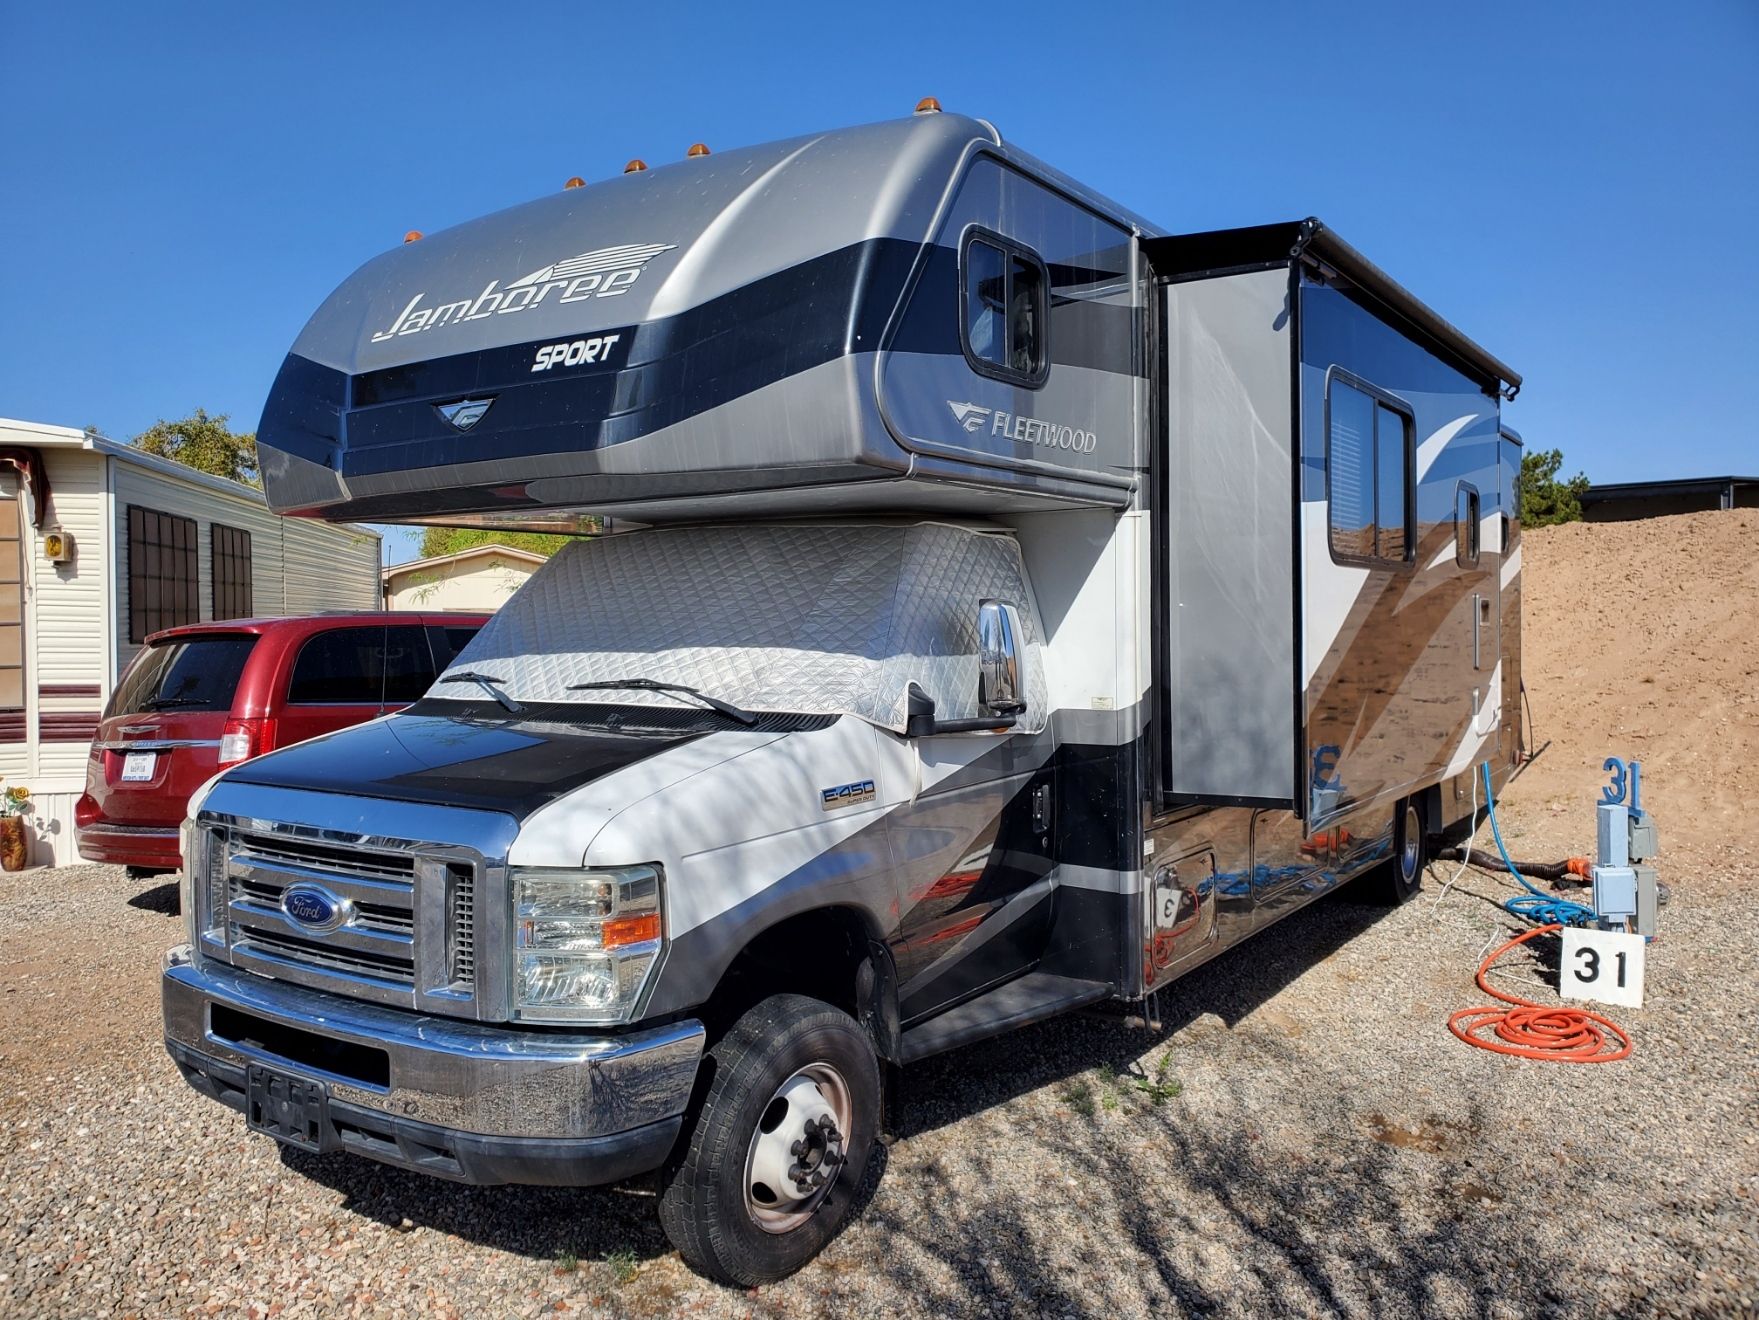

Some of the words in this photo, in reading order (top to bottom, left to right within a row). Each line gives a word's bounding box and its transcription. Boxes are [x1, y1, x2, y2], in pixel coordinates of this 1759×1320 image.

[371, 267, 642, 342] Jamboree
[531, 335, 620, 372] SPORT
[992, 411, 1097, 454] FLEETWOOD
[822, 781, 875, 802] E-450
[1602, 757, 1641, 811] 31
[291, 896, 320, 918] Ford
[1574, 947, 1626, 988] 31
